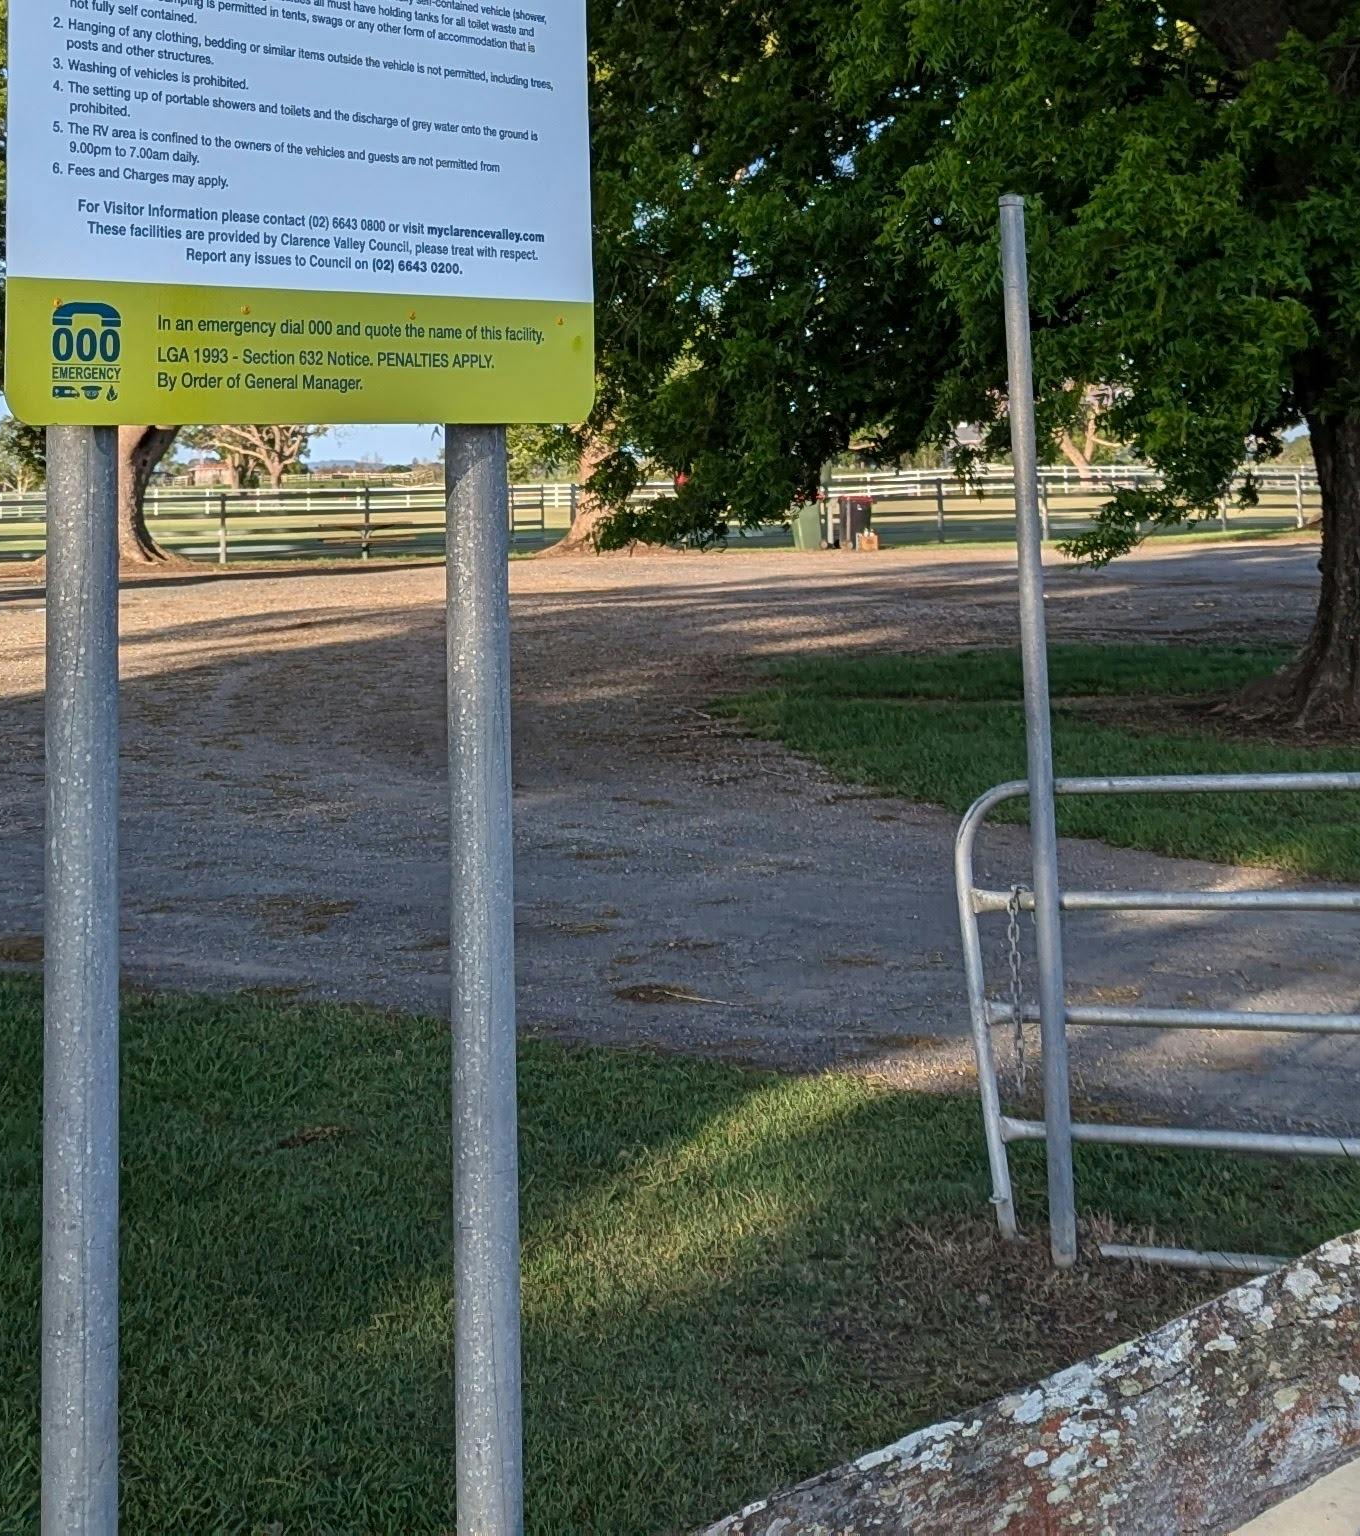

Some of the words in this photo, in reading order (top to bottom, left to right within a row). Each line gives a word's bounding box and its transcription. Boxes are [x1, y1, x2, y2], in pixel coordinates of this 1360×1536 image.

[117, 4, 138, 16] self
[140, 8, 197, 24] contained.
[66, 39, 99, 52] posts
[101, 42, 123, 54] and
[125, 44, 155, 58] other
[157, 48, 214, 65] structures.
[52, 57, 63, 70] 3.
[67, 58, 117, 78] Washing
[119, 65, 131, 77] of
[133, 67, 179, 83] vehicles
[181, 71, 191, 84] is
[193, 74, 249, 90] prohibited.
[69, 101, 130, 117] prohibited.
[69, 140, 112, 158] 9.00pm
[114, 145, 127, 158] to
[129, 146, 170, 161] 7.00am
[172, 150, 200, 166] daily.
[52, 161, 63, 175] 6.
[67, 162, 96, 177] Fees
[98, 166, 120, 179] and
[122, 167, 170, 184] Charges
[172, 174, 195, 187] may
[197, 175, 229, 190] apply.
[78, 198, 100, 213] For
[103, 200, 145, 216] Visitor
[148, 203, 218, 221] Information
[221, 209, 260, 225] please
[262, 213, 306, 227] contact
[308, 215, 329, 231] (02)
[332, 216, 358, 231] 6643
[360, 218, 386, 232] 0800
[388, 223, 400, 233] or
[402, 221, 425, 235] visit
[427, 224, 545, 243] myclarencevalley.com
[86, 220, 127, 236] These
[129, 223, 182, 240] facilities
[185, 229, 205, 241] are
[208, 229, 260, 244] provided
[263, 231, 278, 248] by
[280, 232, 331, 248] Clarence
[333, 236, 366, 253] Valley
[368, 238, 412, 255] Council,
[414, 241, 449, 257] please
[450, 244, 474, 257] treat
[476, 245, 497, 258] with
[499, 249, 538, 262] respect.
[186, 247, 227, 264] Report
[229, 252, 251, 267] any
[294, 254, 306, 267] to
[309, 254, 352, 269] Council
[354, 259, 369, 270] on
[372, 257, 395, 274] (02)
[397, 259, 428, 273] 6643
[430, 261, 463, 275] 0200.
[157, 314, 171, 331] In
[175, 318, 193, 331] an
[197, 319, 277, 338] emergency
[279, 318, 305, 335] dial
[308, 319, 333, 336] 000
[336, 321, 361, 336] and
[364, 323, 402, 340] quote
[404, 323, 425, 338] the
[428, 327, 462, 339] name
[465, 325, 478, 340] of
[480, 325, 502, 341] this
[504, 326, 545, 345] facility.
[52, 327, 121, 362] 000
[157, 346, 190, 363] LGA
[193, 347, 229, 364] 1993
[242, 348, 295, 365] Section
[298, 350, 324, 366] 632
[327, 350, 374, 367] Notice.
[377, 351, 449, 368] PENALTIES
[451, 353, 495, 369] APPLY.
[51, 366, 121, 380] EMERGENCY
[157, 371, 177, 392] By
[181, 372, 223, 389] Order
[226, 373, 241, 389] of
[244, 373, 298, 390] General
[302, 374, 363, 393] Manager.
